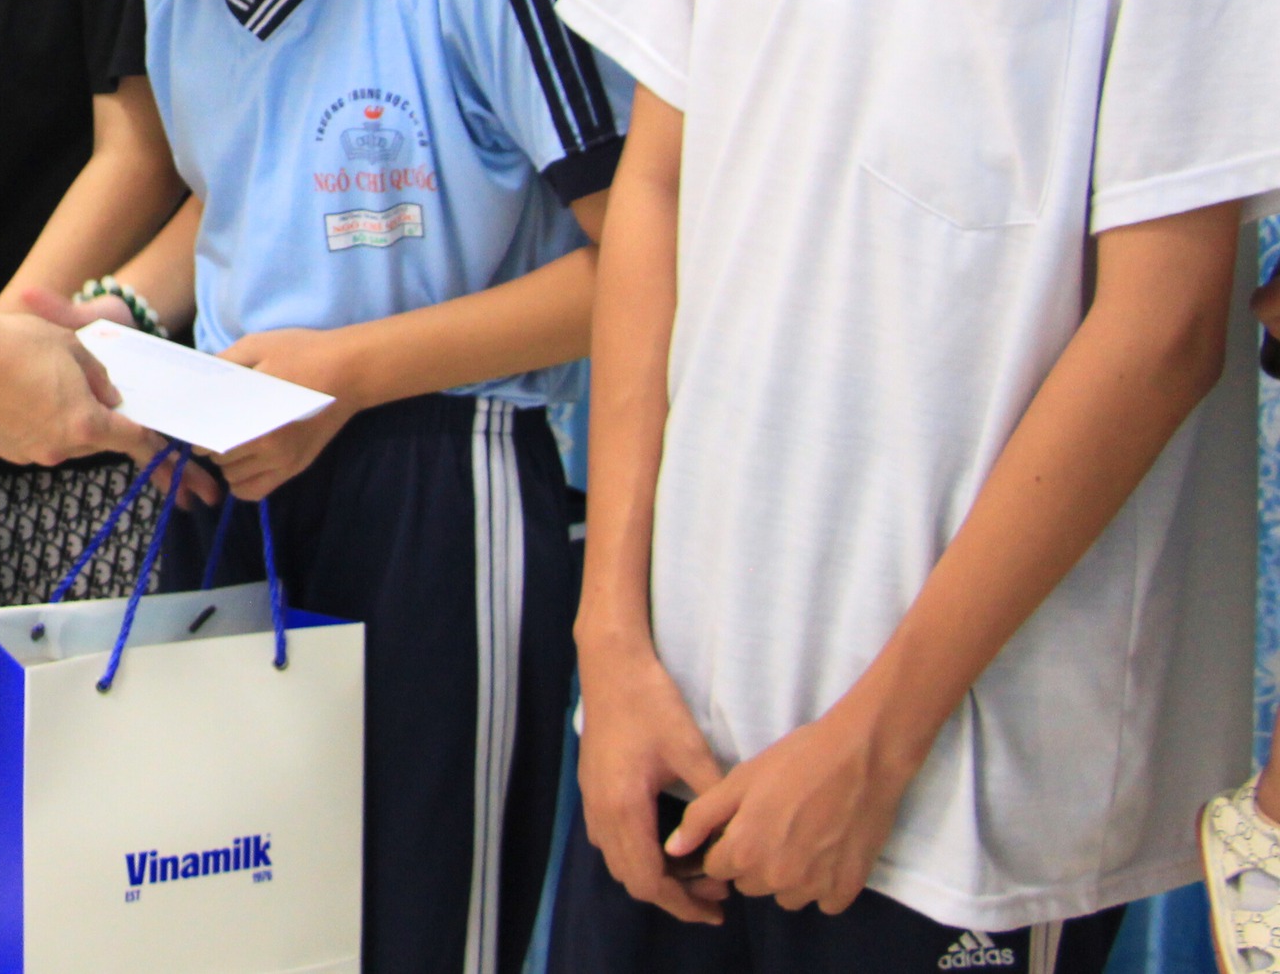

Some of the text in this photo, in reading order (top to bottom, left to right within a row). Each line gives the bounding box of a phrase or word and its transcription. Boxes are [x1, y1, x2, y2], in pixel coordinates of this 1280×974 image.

[313, 167, 351, 193] NGÔ
[355, 167, 387, 194] CHÍ
[124, 834, 272, 887] Vinamilk
[937, 947, 1015, 970] adidas
